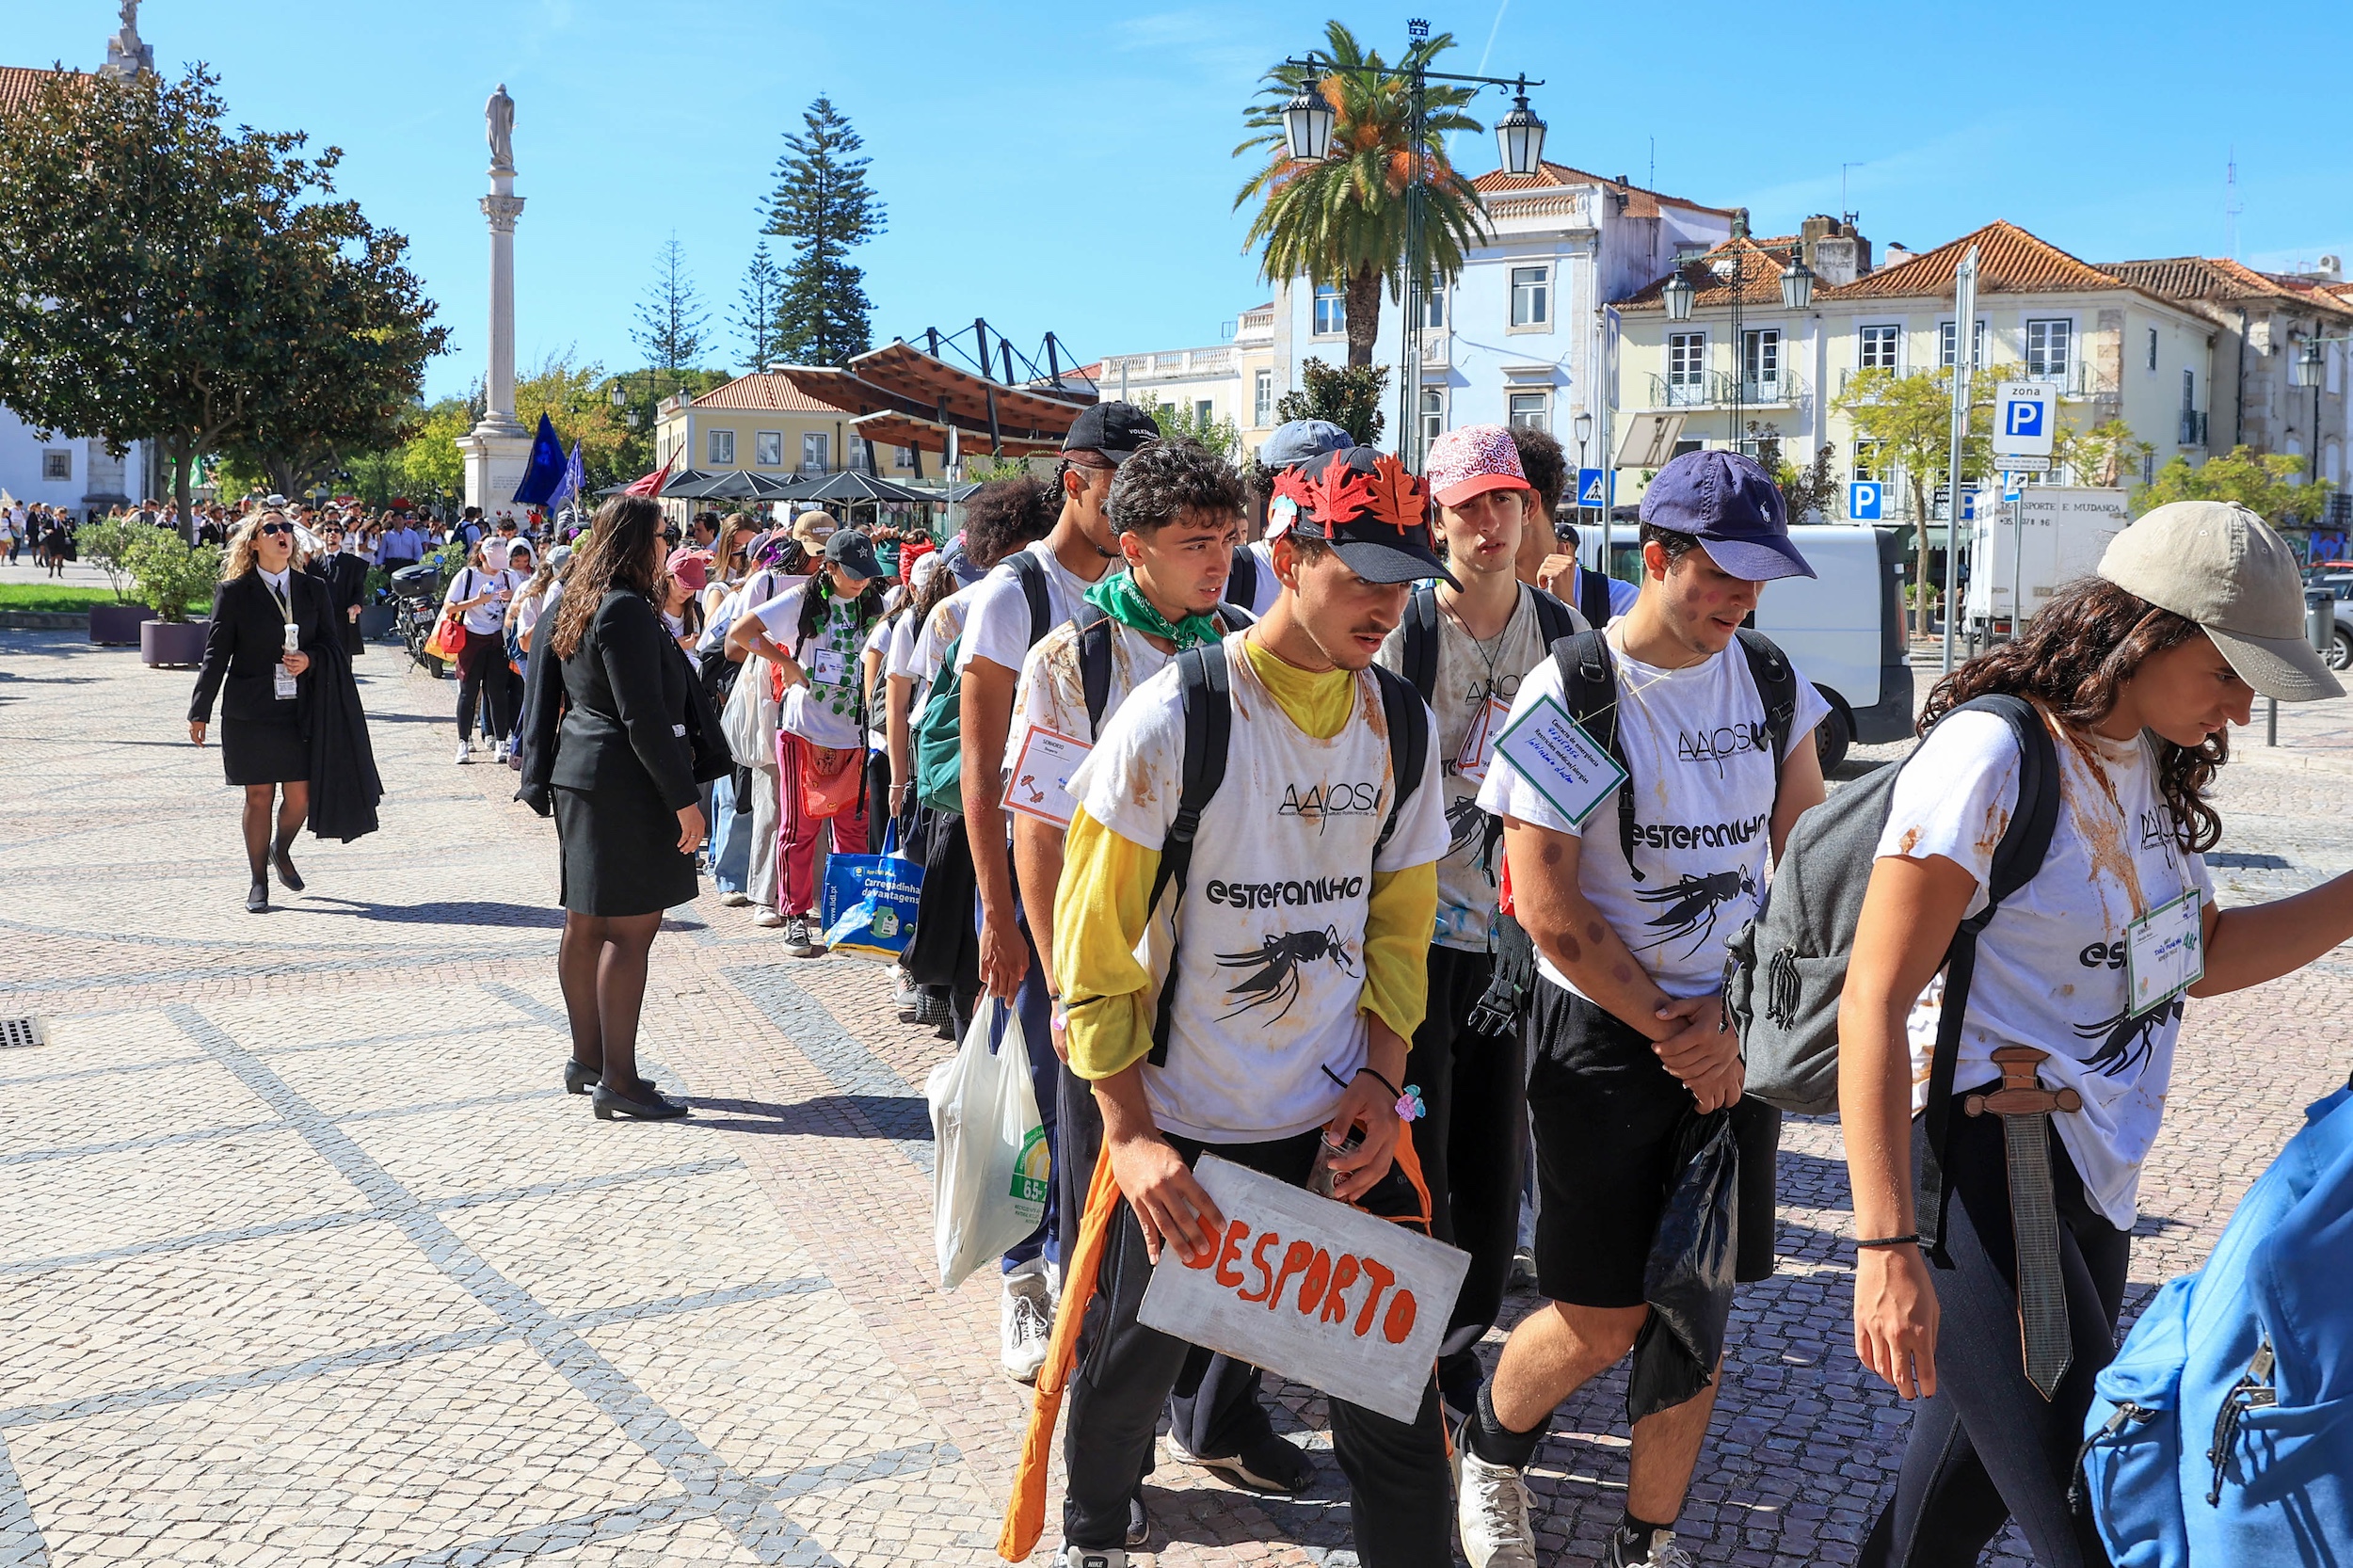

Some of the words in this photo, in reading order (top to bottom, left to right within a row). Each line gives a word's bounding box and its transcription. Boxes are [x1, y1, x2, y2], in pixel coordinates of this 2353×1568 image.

[2012, 388, 2041, 396] zona
[2011, 403, 2038, 434] P
[1855, 486, 1876, 517] P
[1960, 491, 1974, 517] P
[2062, 503, 2070, 511] E
[1551, 718, 1571, 739] Contacto
[1569, 736, 1577, 744] de
[1575, 741, 1599, 767] emergência
[1555, 749, 1590, 785] médicas/alergias
[864, 877, 921, 895] Carregadinha
[872, 888, 920, 904] vantagens
[829, 886, 839, 925] www.lidl.pt
[1023, 1179, 1048, 1200] 65-
[1181, 1213, 1417, 1345] DESPORTO
